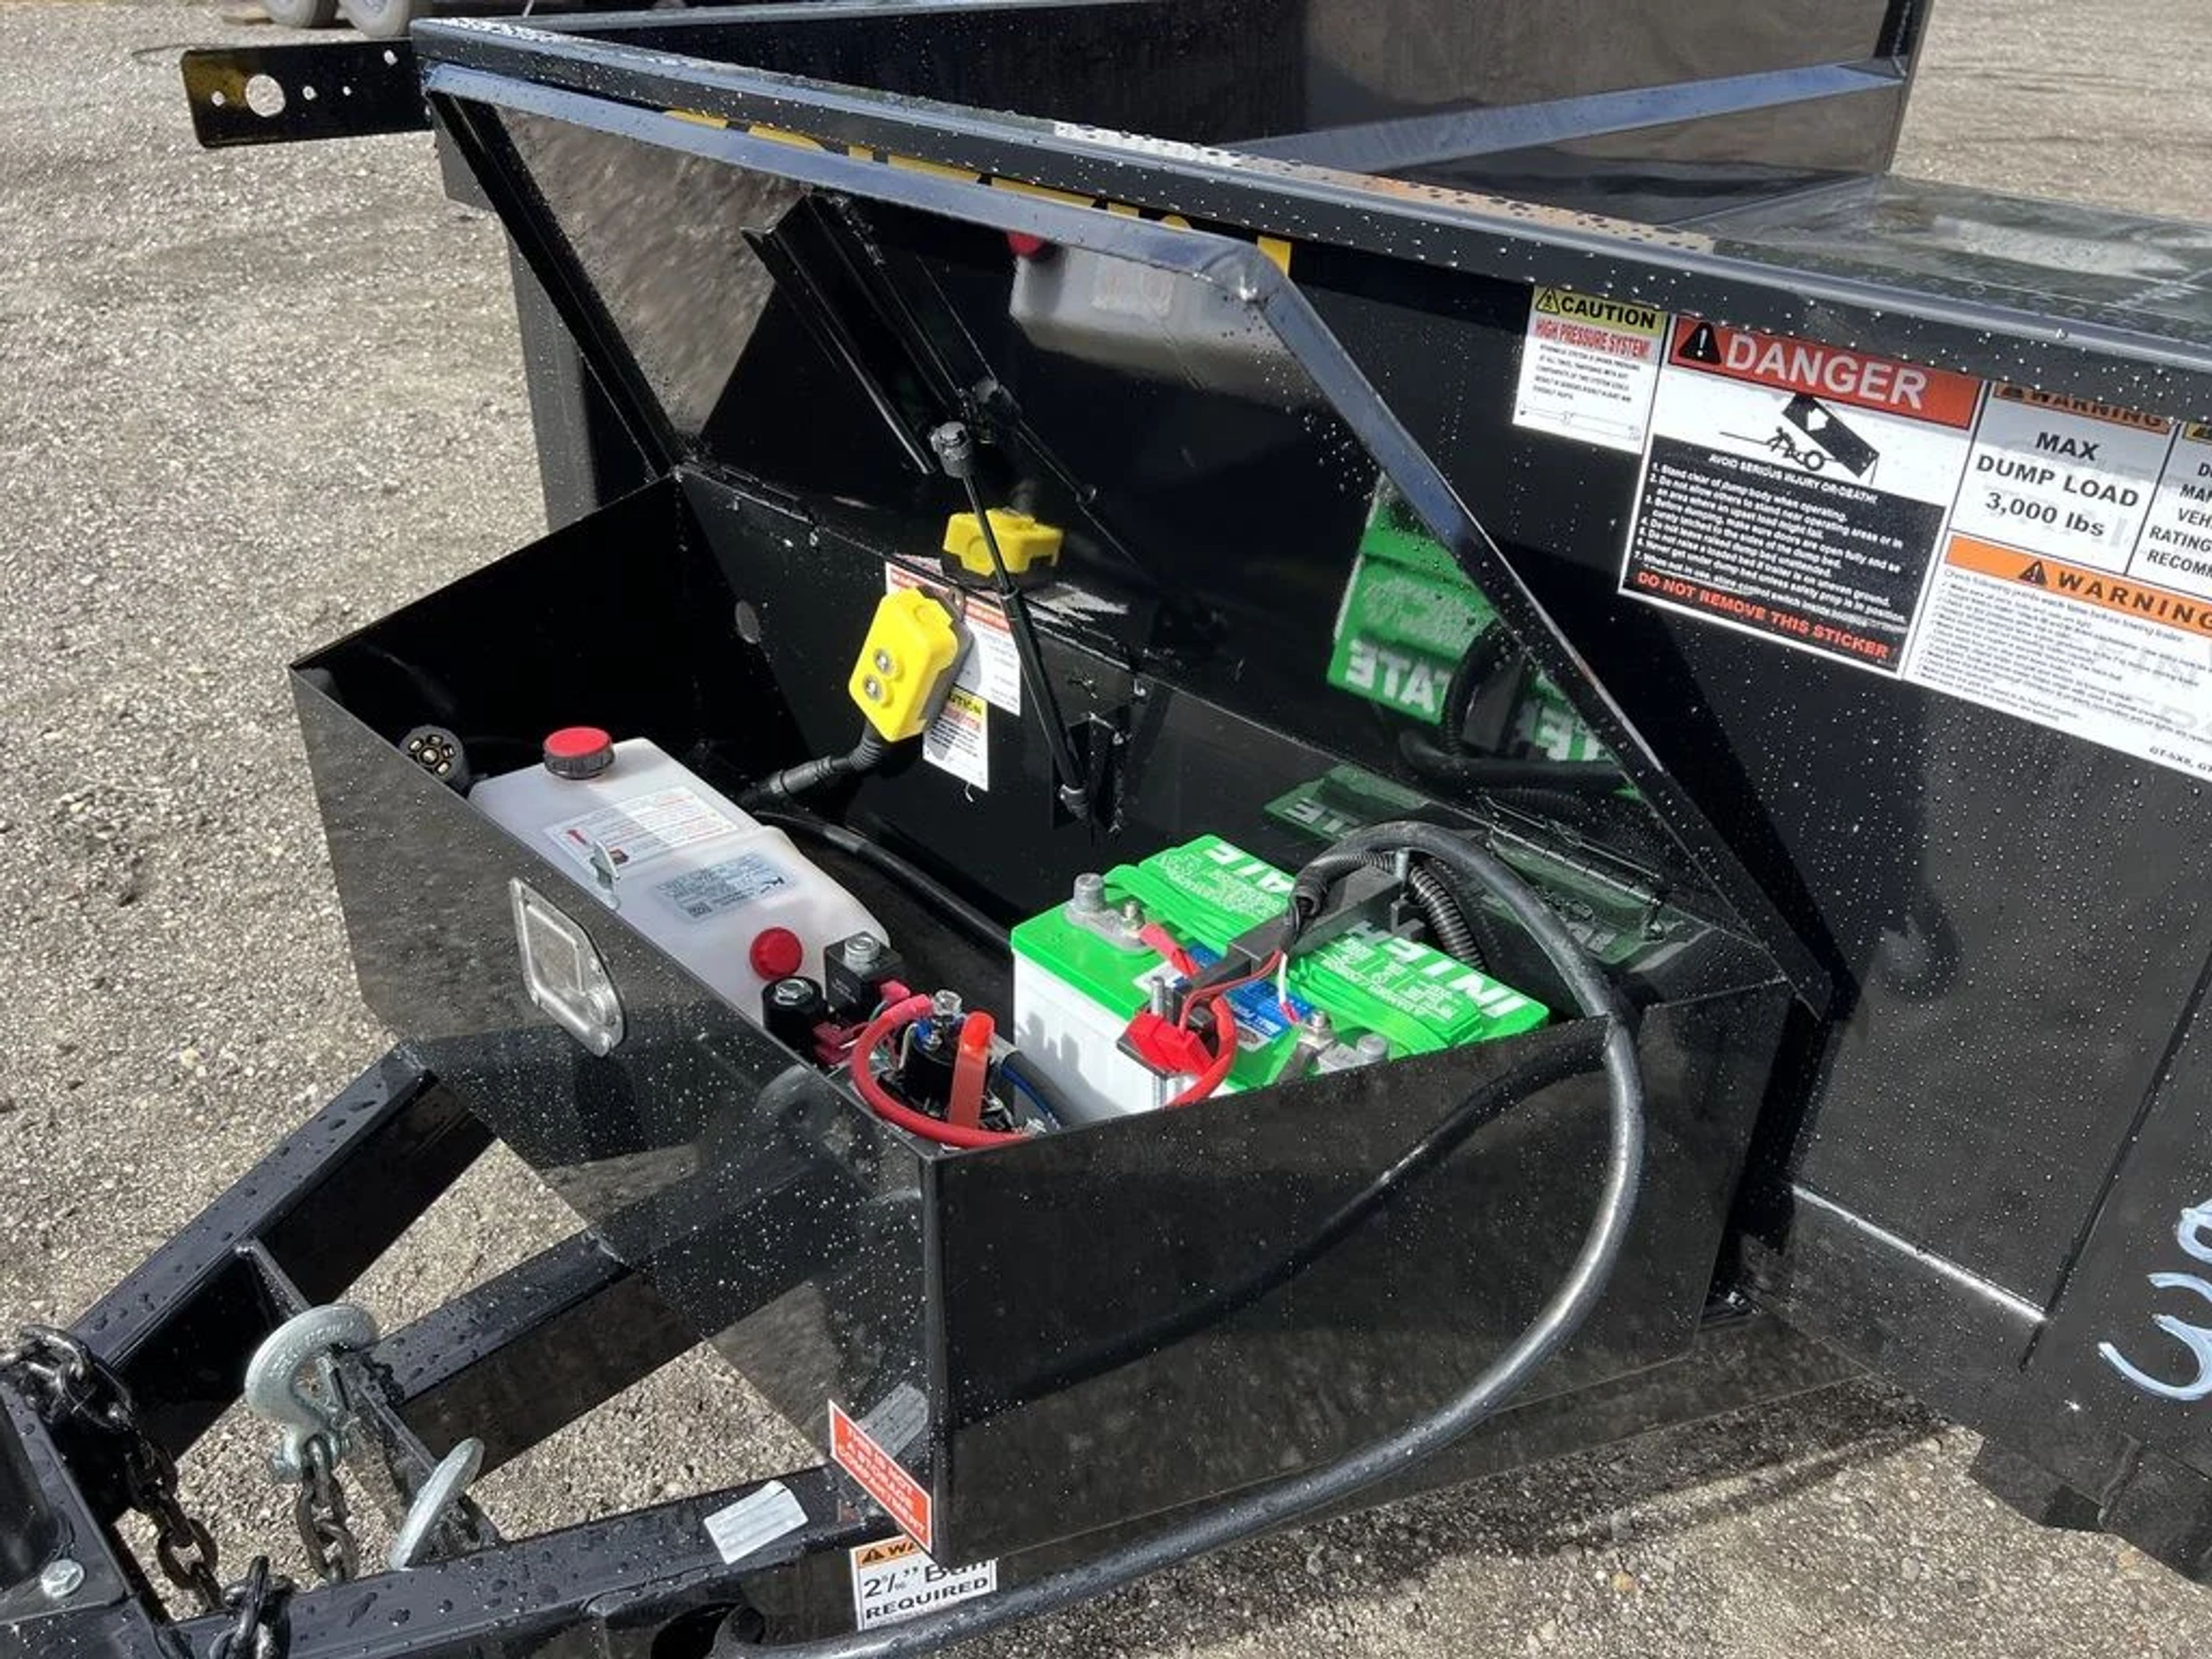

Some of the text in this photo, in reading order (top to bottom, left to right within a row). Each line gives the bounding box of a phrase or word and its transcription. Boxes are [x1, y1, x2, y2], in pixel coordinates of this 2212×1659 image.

[1561, 296, 1657, 329] CAUTION
[1725, 332, 1928, 410] DANGER
[2035, 431, 2100, 461] MAX
[1739, 461, 1783, 480] SERIOUS
[1784, 472, 1819, 488] INJURY
[1976, 454, 2139, 507] DUMP LOAD
[1985, 491, 2105, 536] 3,000 lbs
[1638, 571, 1660, 587] DO
[1662, 578, 1696, 599] NOT
[1699, 589, 1766, 619] REMOVE
[1769, 611, 1810, 634] THIS
[1812, 624, 1889, 658] STICKER
[866, 1577, 988, 1619] REQUIRED
